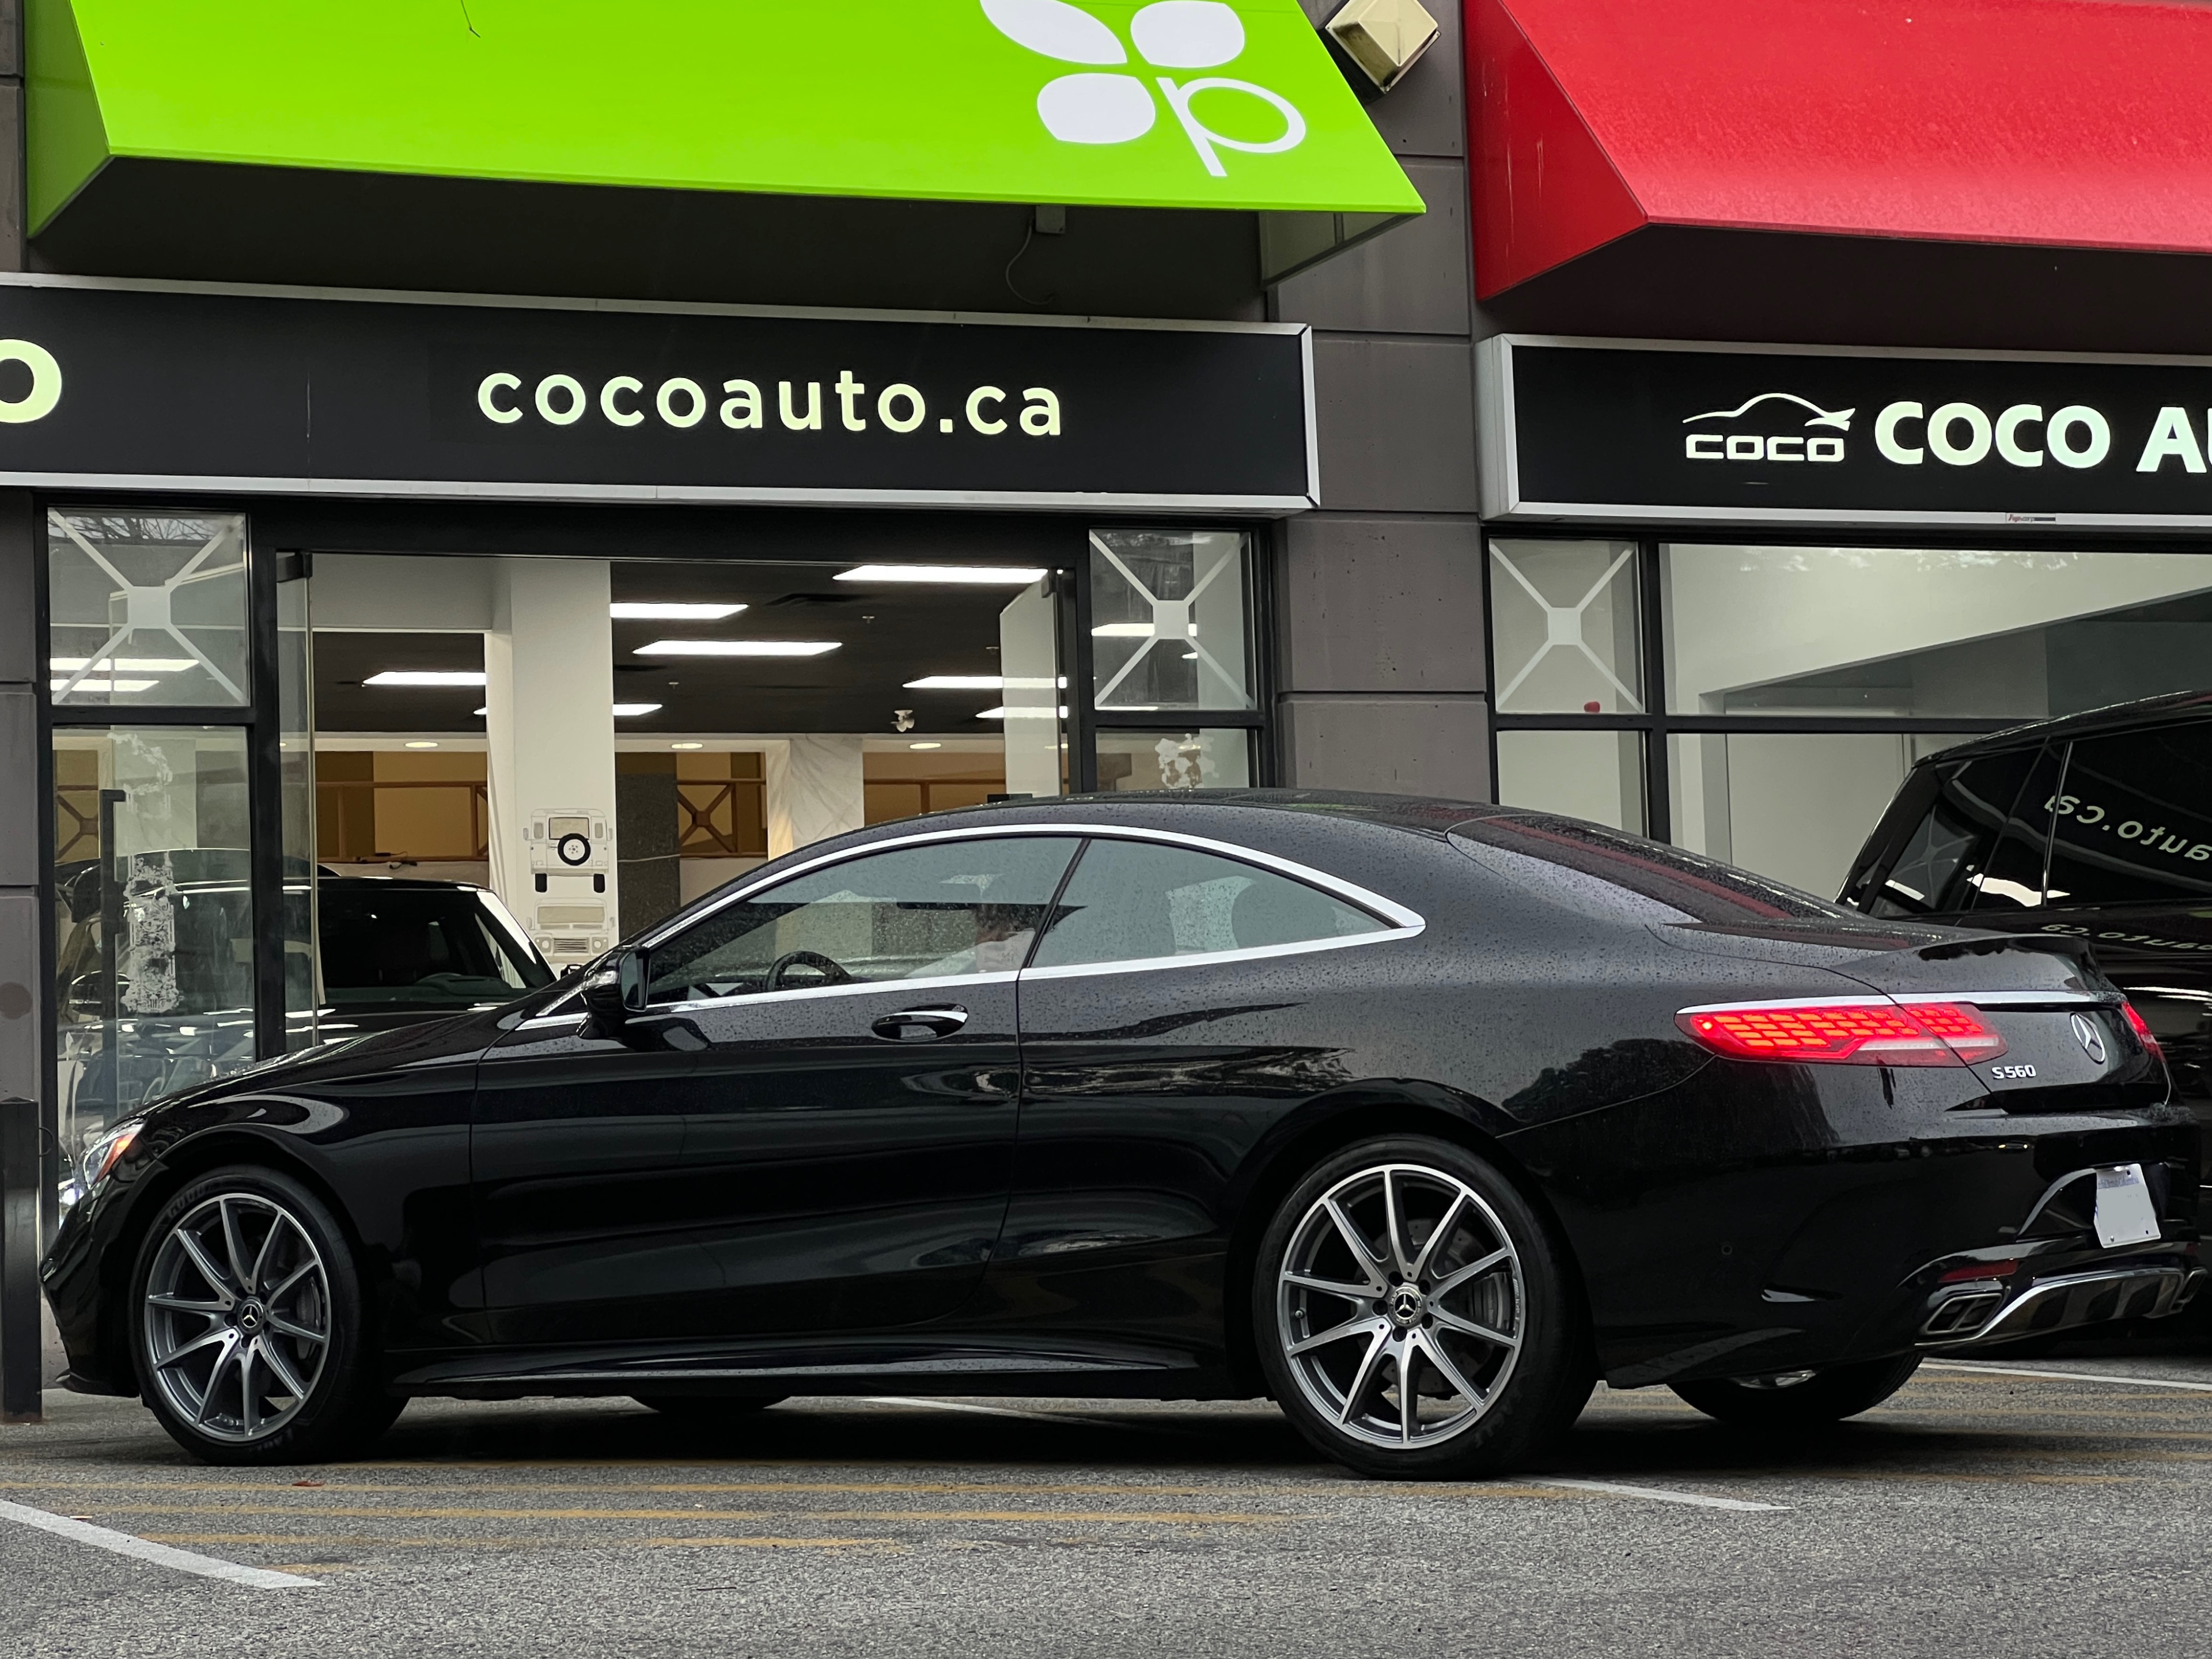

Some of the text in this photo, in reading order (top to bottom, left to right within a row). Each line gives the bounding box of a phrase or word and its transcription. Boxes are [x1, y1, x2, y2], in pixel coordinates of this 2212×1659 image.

[478, 370, 1061, 436] cocoauto.ca
[1685, 434, 1844, 462] COCO
[1874, 401, 2212, 474] COCO A
